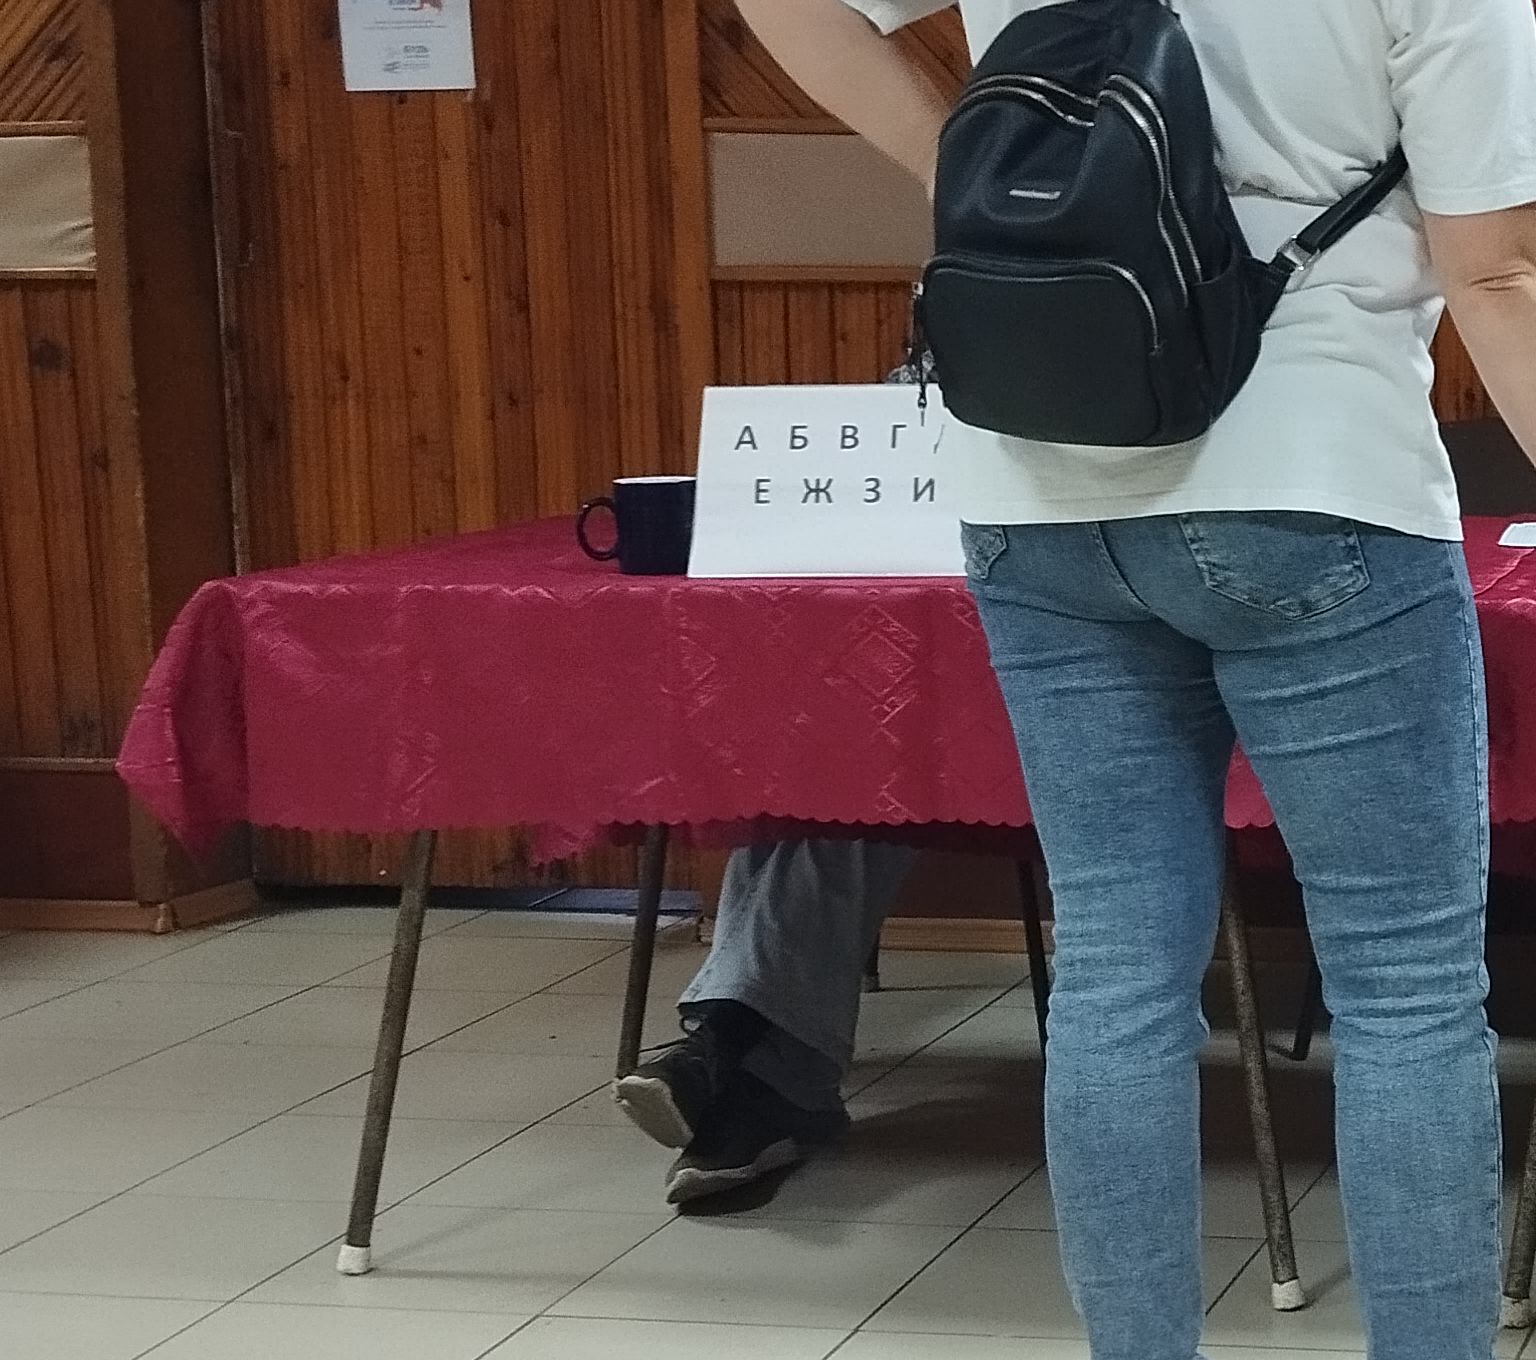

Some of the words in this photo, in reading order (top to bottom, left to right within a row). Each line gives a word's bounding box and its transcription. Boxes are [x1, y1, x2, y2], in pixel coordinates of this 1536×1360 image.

[733, 425, 758, 450] А
[789, 425, 808, 450] Б
[840, 425, 859, 450] В
[890, 424, 907, 449] Г
[754, 478, 771, 504] Е
[801, 478, 834, 504] Ж
[863, 477, 881, 504] З
[912, 477, 935, 503] И
